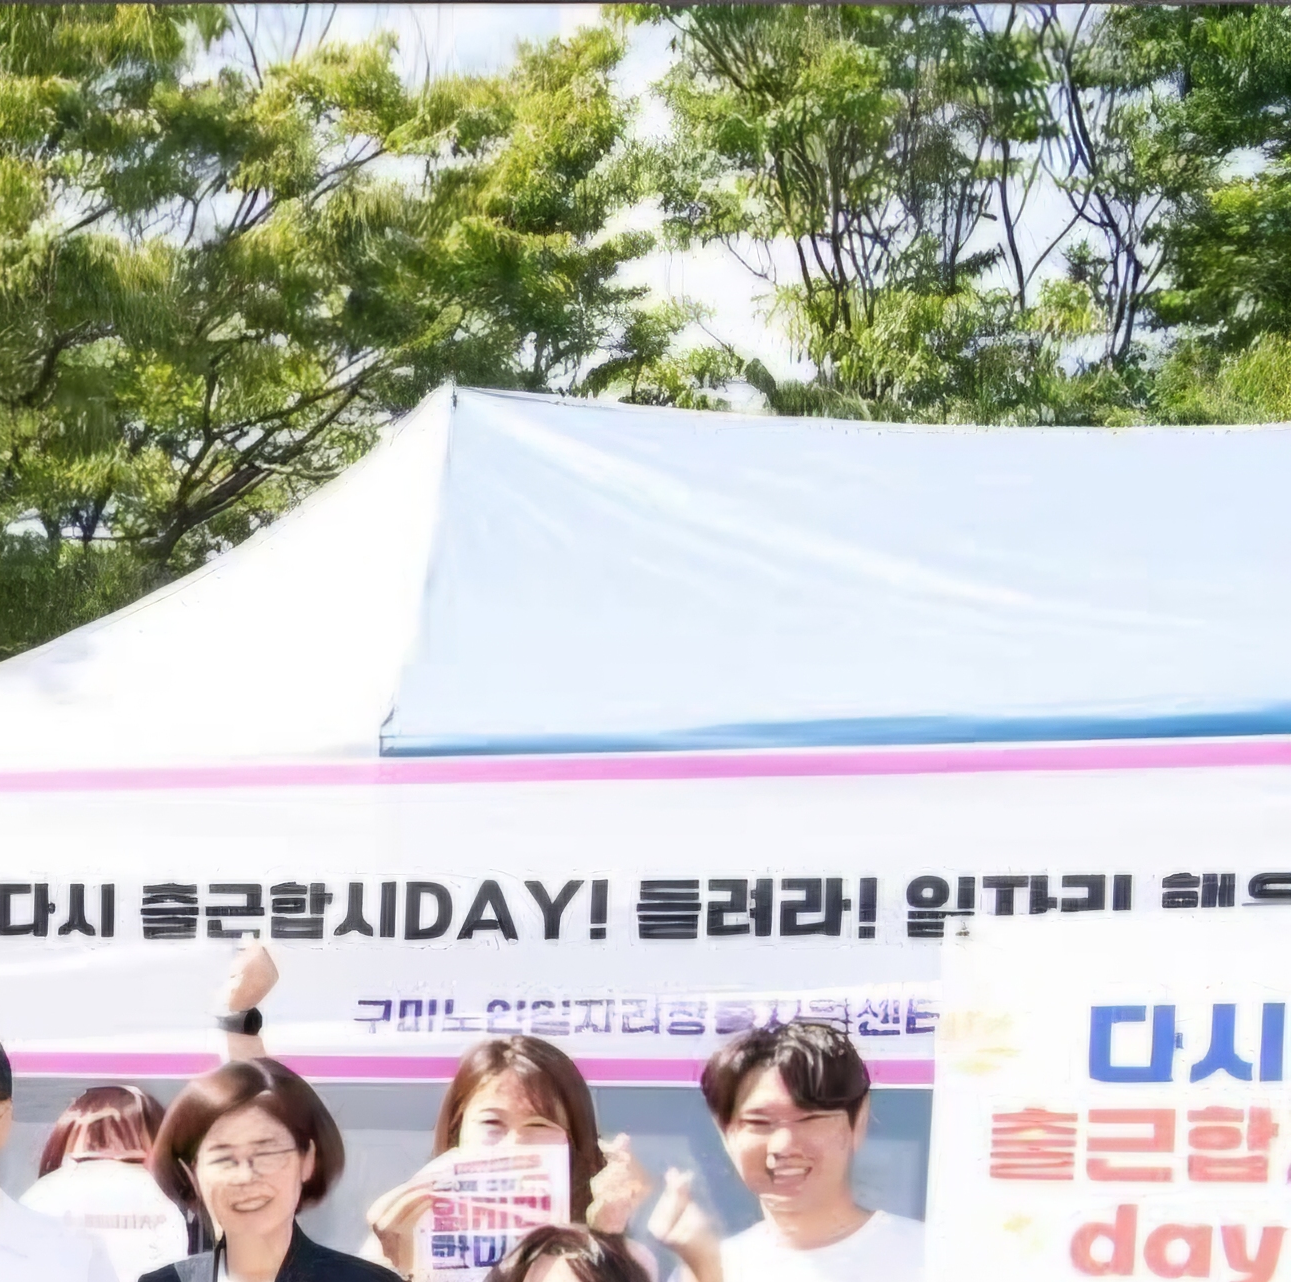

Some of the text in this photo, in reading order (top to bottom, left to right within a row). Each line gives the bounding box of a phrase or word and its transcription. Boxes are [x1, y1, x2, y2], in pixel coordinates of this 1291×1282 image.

[140, 878, 608, 941] 출근합시DAY!
[906, 874, 1132, 939] 일자리
[1089, 1002, 1286, 1084] 다시
[989, 1105, 1291, 1183] 출근합
